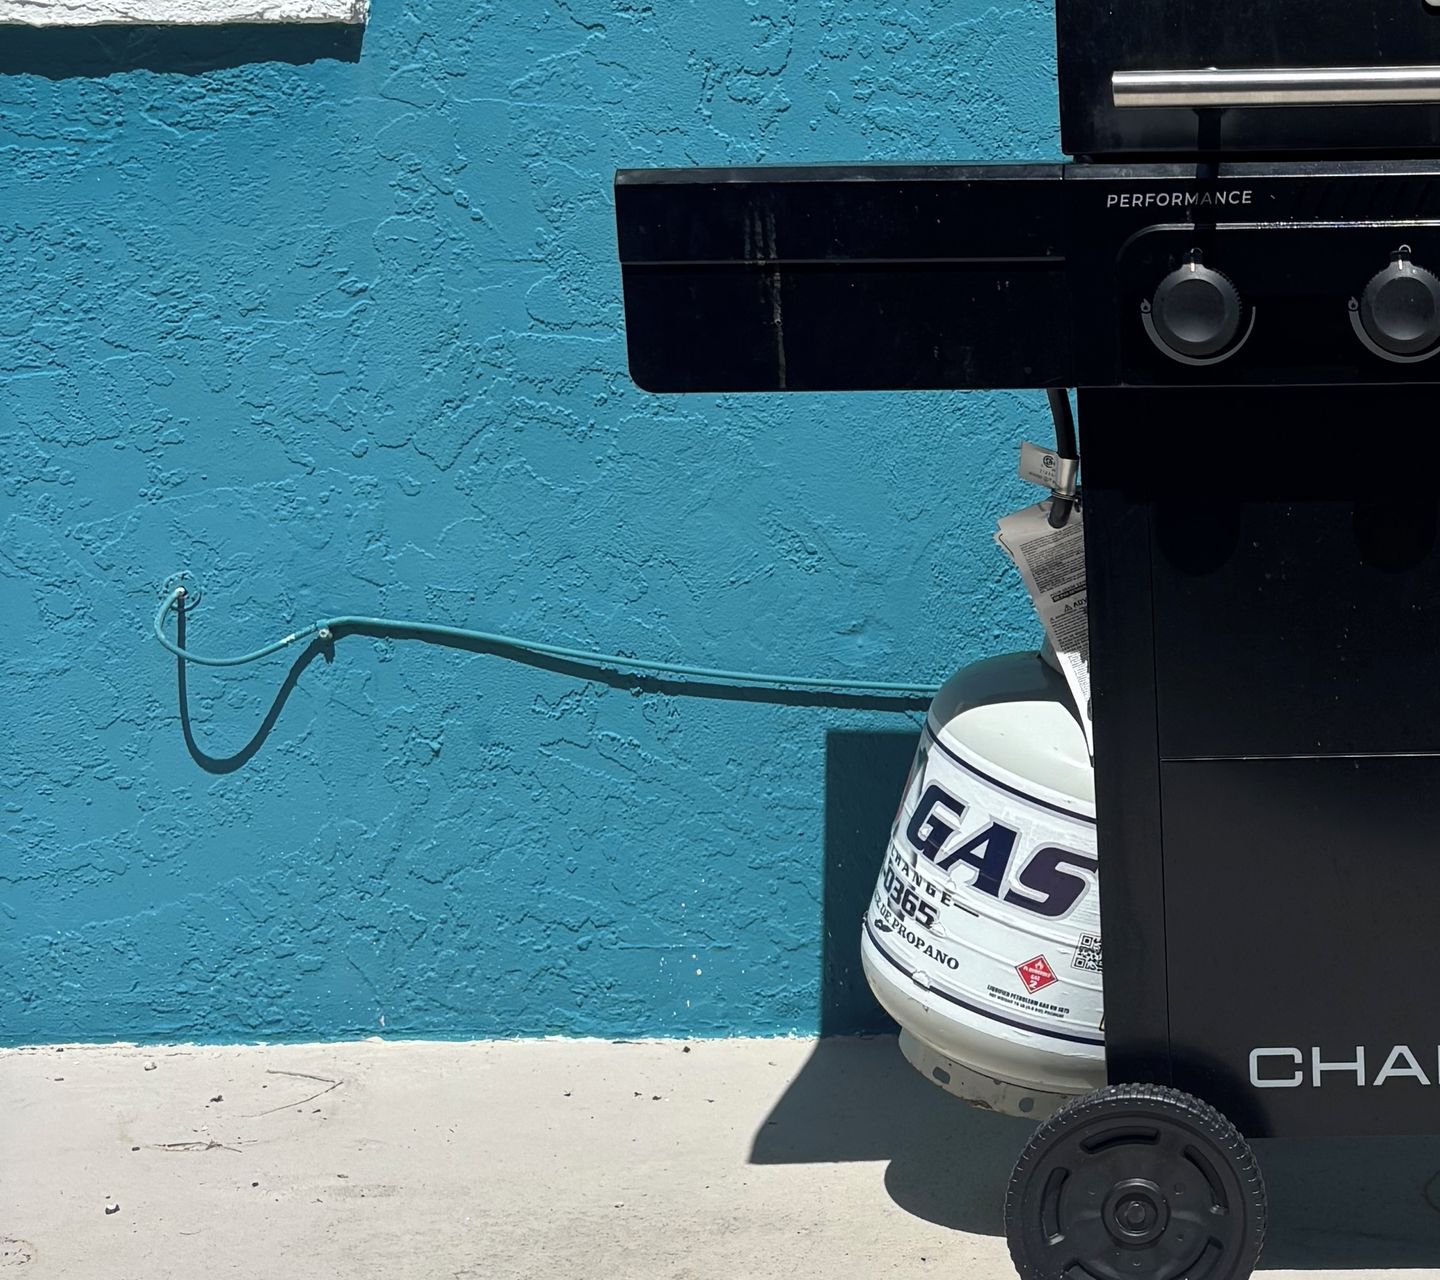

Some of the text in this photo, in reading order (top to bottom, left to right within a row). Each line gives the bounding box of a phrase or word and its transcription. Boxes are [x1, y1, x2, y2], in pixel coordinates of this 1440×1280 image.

[1106, 190, 1253, 208] PERFORMANCE
[905, 781, 1099, 918] GAS
[890, 919, 960, 970] PROPANO
